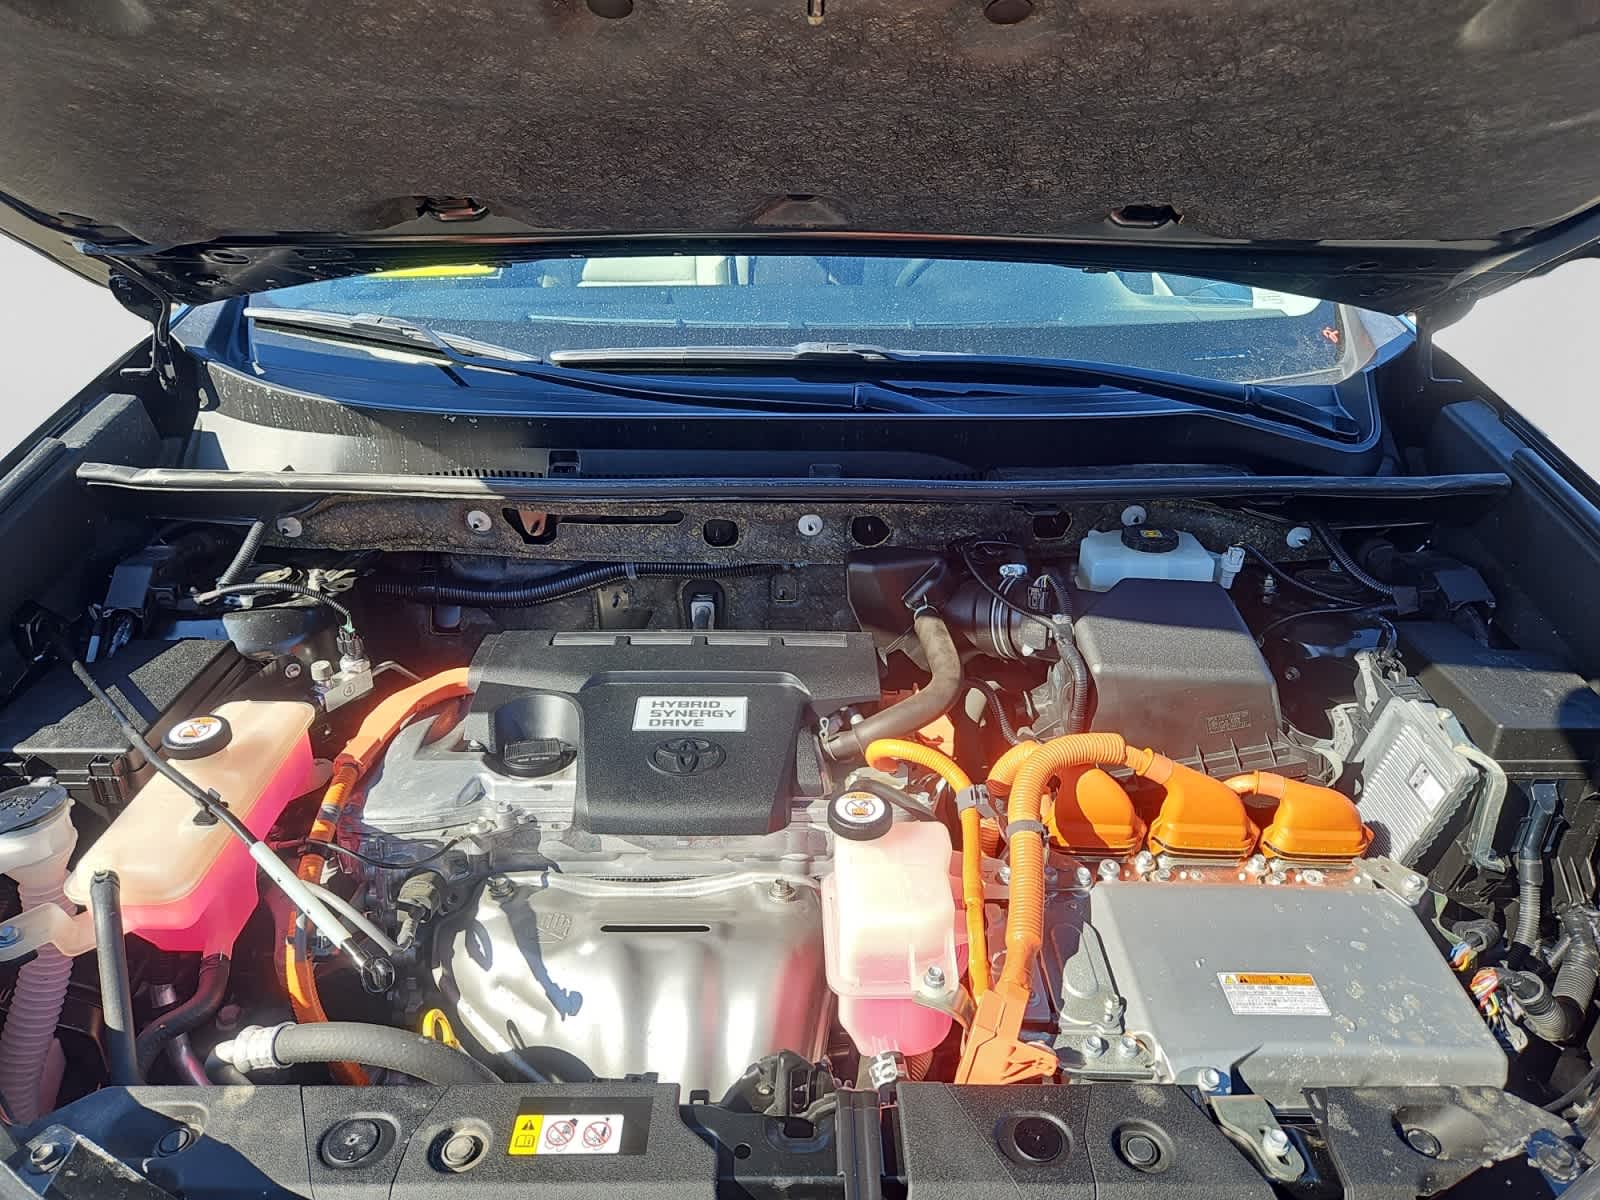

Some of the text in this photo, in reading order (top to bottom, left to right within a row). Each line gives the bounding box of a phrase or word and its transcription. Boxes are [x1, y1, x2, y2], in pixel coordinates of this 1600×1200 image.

[651, 700, 721, 709] HYBRID
[649, 709, 737, 718] SYNERGY
[648, 719, 705, 727] DRIVE
